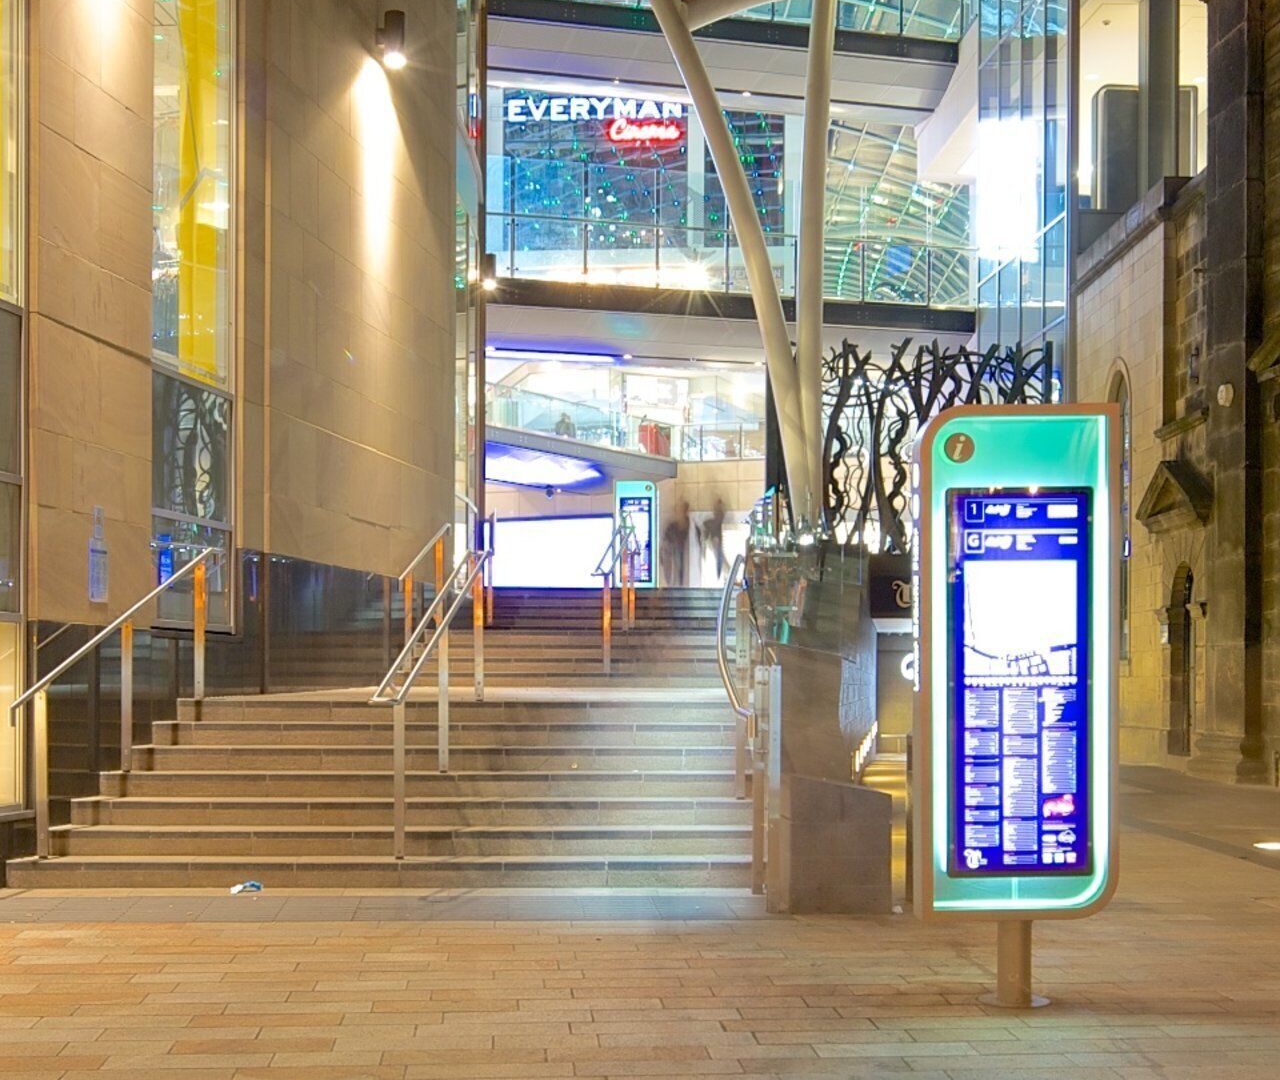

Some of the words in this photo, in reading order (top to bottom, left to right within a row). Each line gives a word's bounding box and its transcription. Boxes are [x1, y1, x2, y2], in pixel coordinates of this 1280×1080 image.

[507, 96, 683, 123] EVERYMAN
[608, 118, 681, 142] Cinema
[967, 534, 980, 548] G
